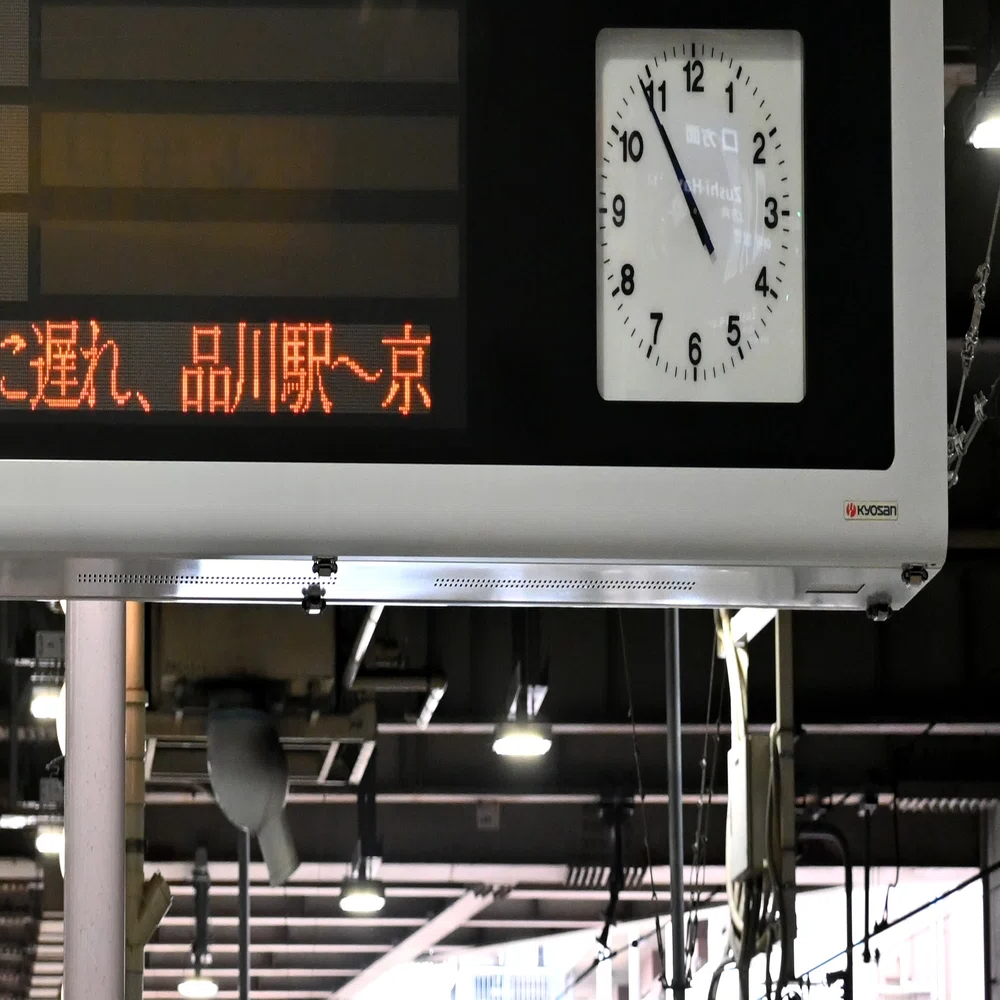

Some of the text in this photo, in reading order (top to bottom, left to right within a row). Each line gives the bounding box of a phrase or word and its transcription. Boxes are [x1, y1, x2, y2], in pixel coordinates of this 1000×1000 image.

[683, 60, 704, 92] 12
[725, 82, 733, 113] 1
[618, 131, 643, 162] 10
[753, 132, 765, 164] 2
[613, 194, 625, 227] 9
[764, 197, 778, 229] 3
[619, 264, 634, 295] 8
[755, 266, 769, 297] 4
[650, 313, 663, 345] 7
[727, 316, 741, 346] 5
[688, 332, 702, 366] 6
